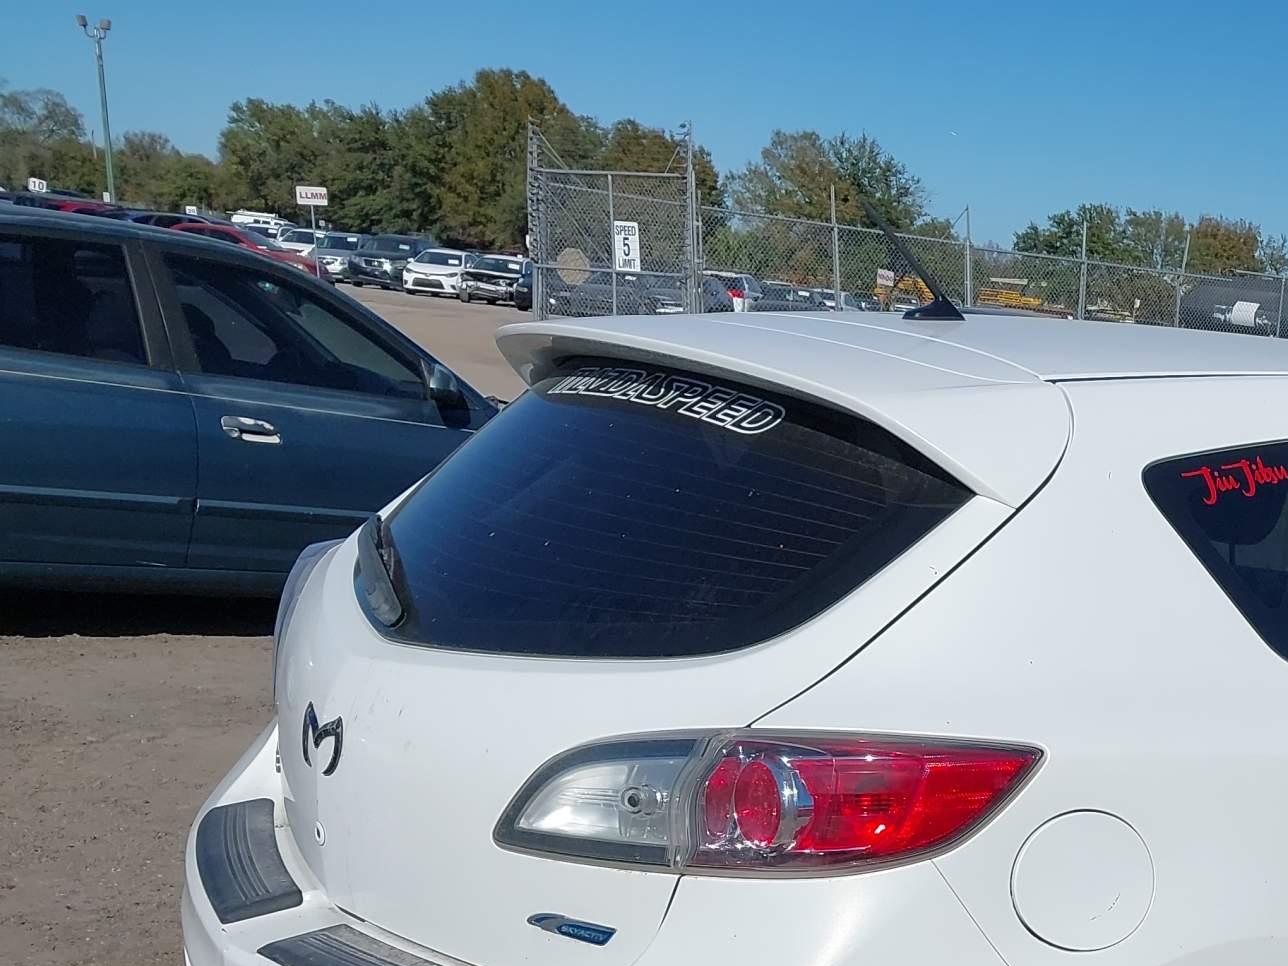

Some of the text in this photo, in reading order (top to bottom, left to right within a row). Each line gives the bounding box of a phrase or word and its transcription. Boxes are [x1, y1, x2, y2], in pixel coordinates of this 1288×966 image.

[31, 180, 45, 191] 10
[299, 191, 327, 201] LLMM
[615, 224, 636, 236] SPEED
[622, 236, 631, 257] 5
[618, 257, 636, 270] LIMIT
[560, 925, 610, 941] SKYACTIV
